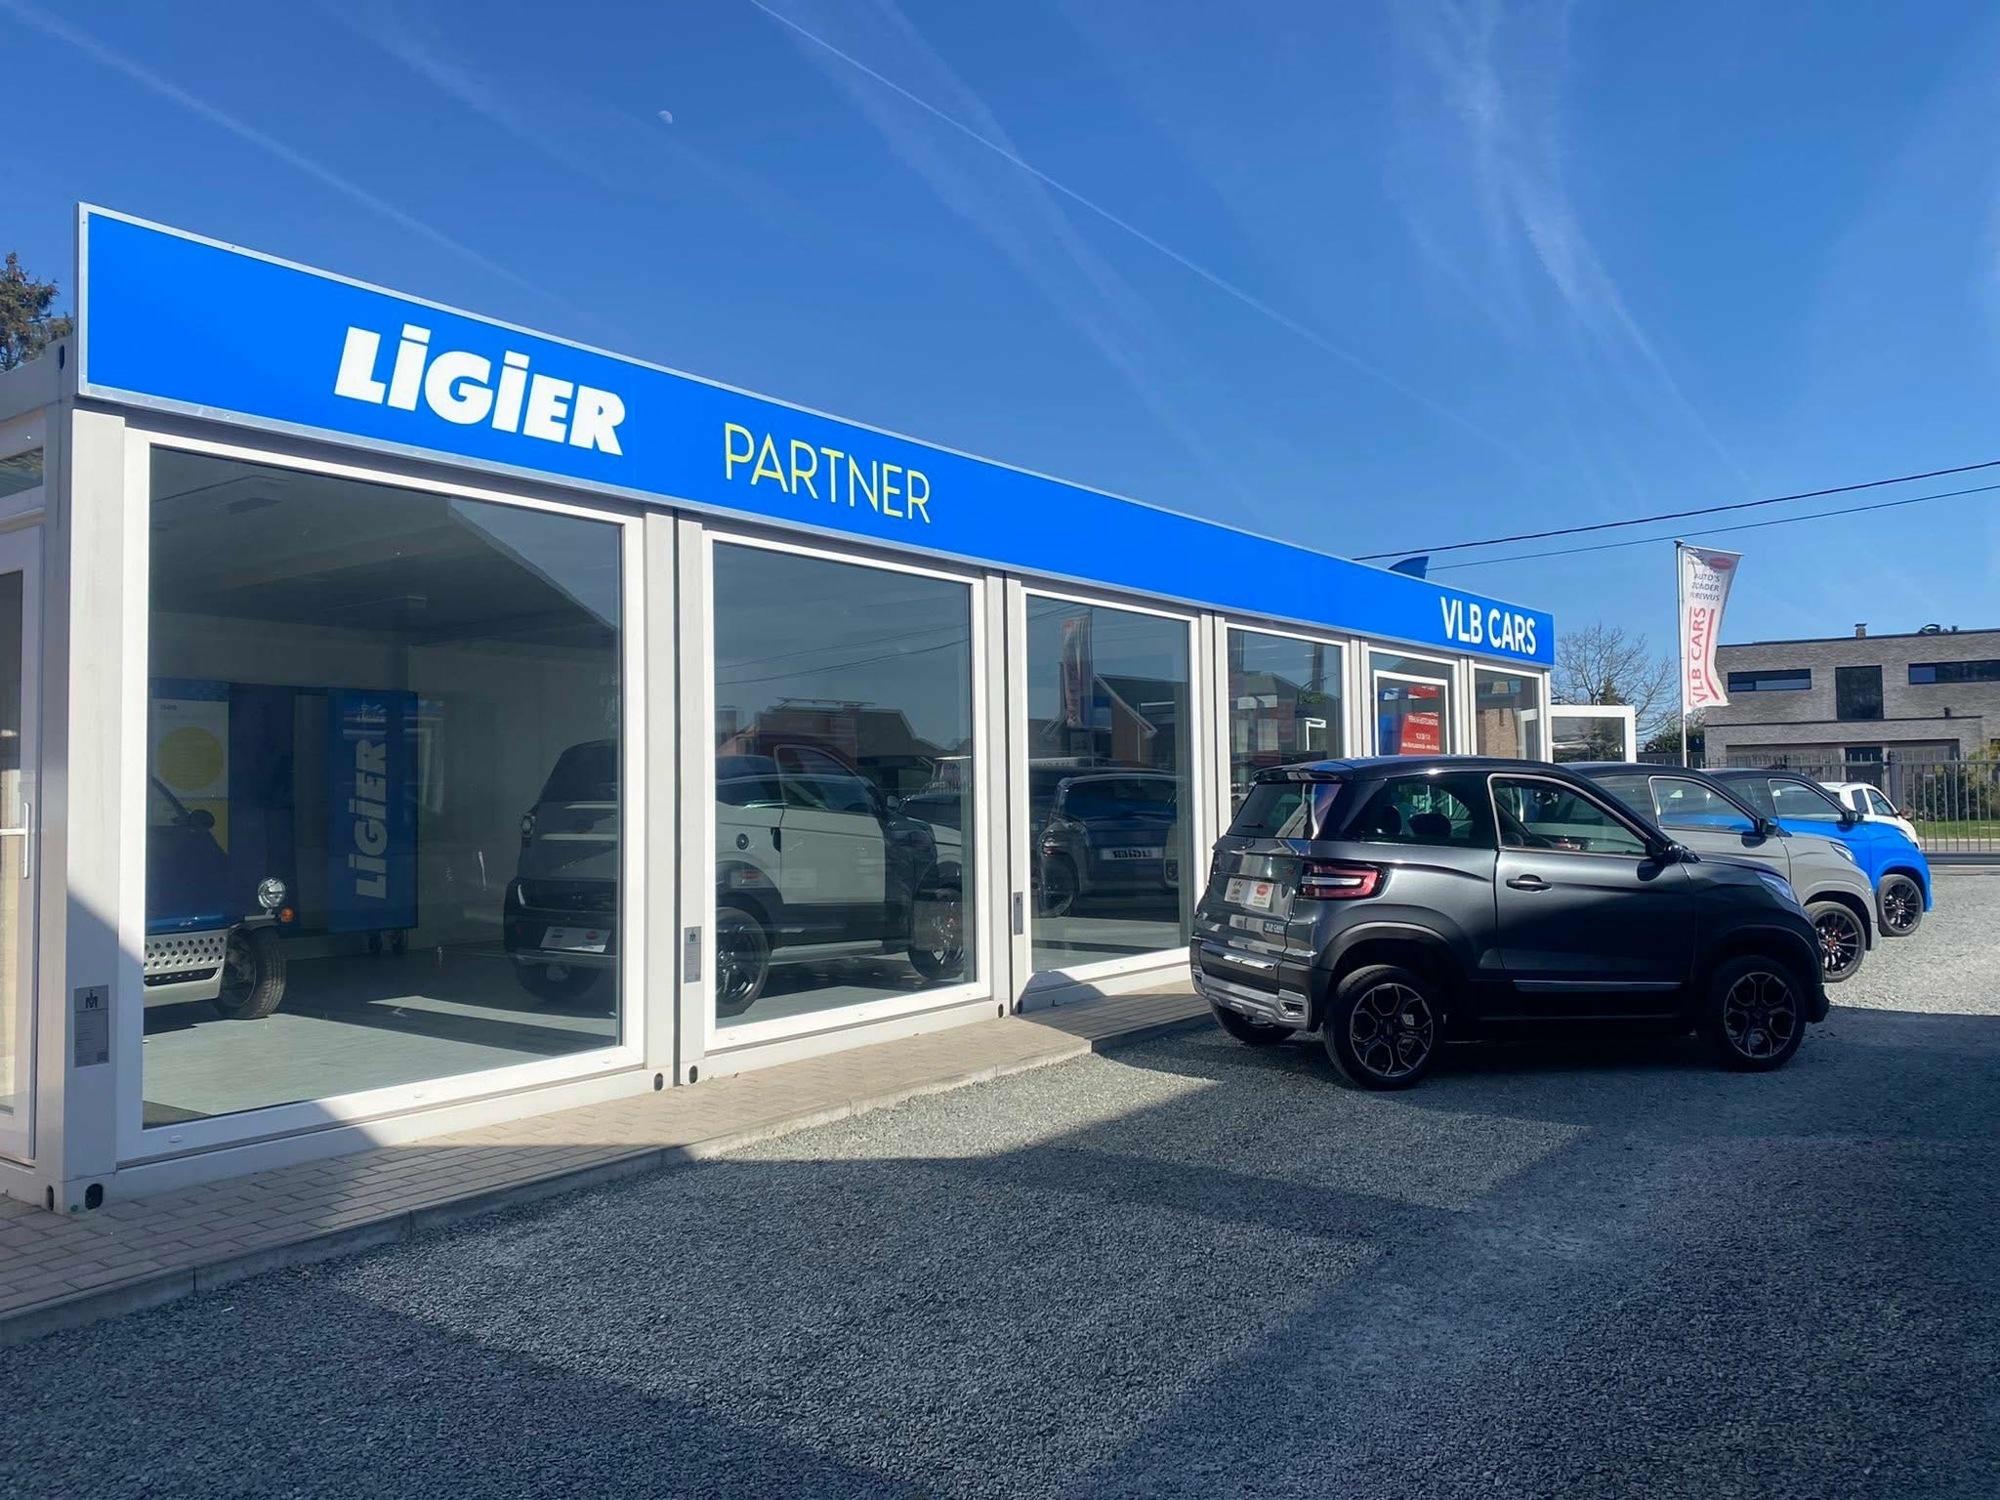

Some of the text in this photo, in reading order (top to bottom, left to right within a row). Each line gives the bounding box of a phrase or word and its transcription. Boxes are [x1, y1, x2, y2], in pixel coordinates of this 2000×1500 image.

[724, 422, 931, 524] PARTNER
[1440, 596, 1537, 655] VLB CARS
[1691, 607, 1708, 703] VLB CARS
